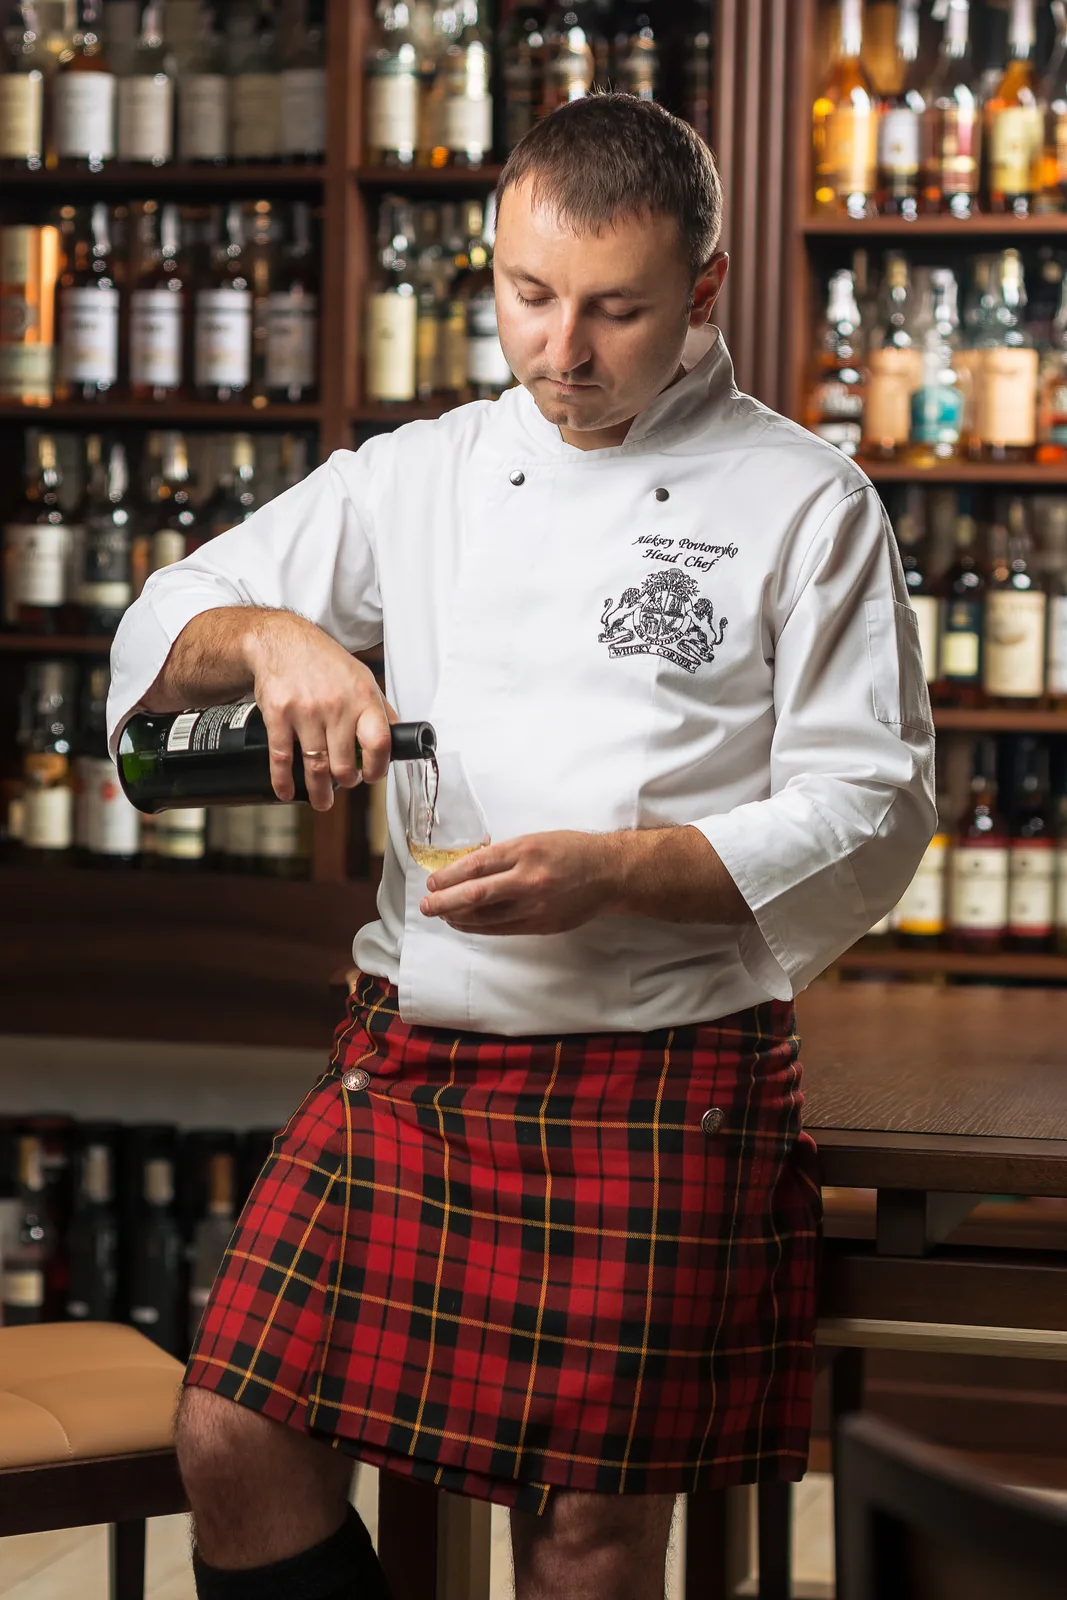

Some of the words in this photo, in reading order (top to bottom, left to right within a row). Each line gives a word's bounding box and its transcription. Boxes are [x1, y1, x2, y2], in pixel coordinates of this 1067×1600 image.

[632, 534, 674, 549] Aleksey
[679, 538, 738, 558] Povtoreyko
[642, 549, 683, 563] Head
[684, 555, 719, 572] Chef
[614, 645, 651, 656] WHISKY
[656, 648, 693, 669] CORNER
